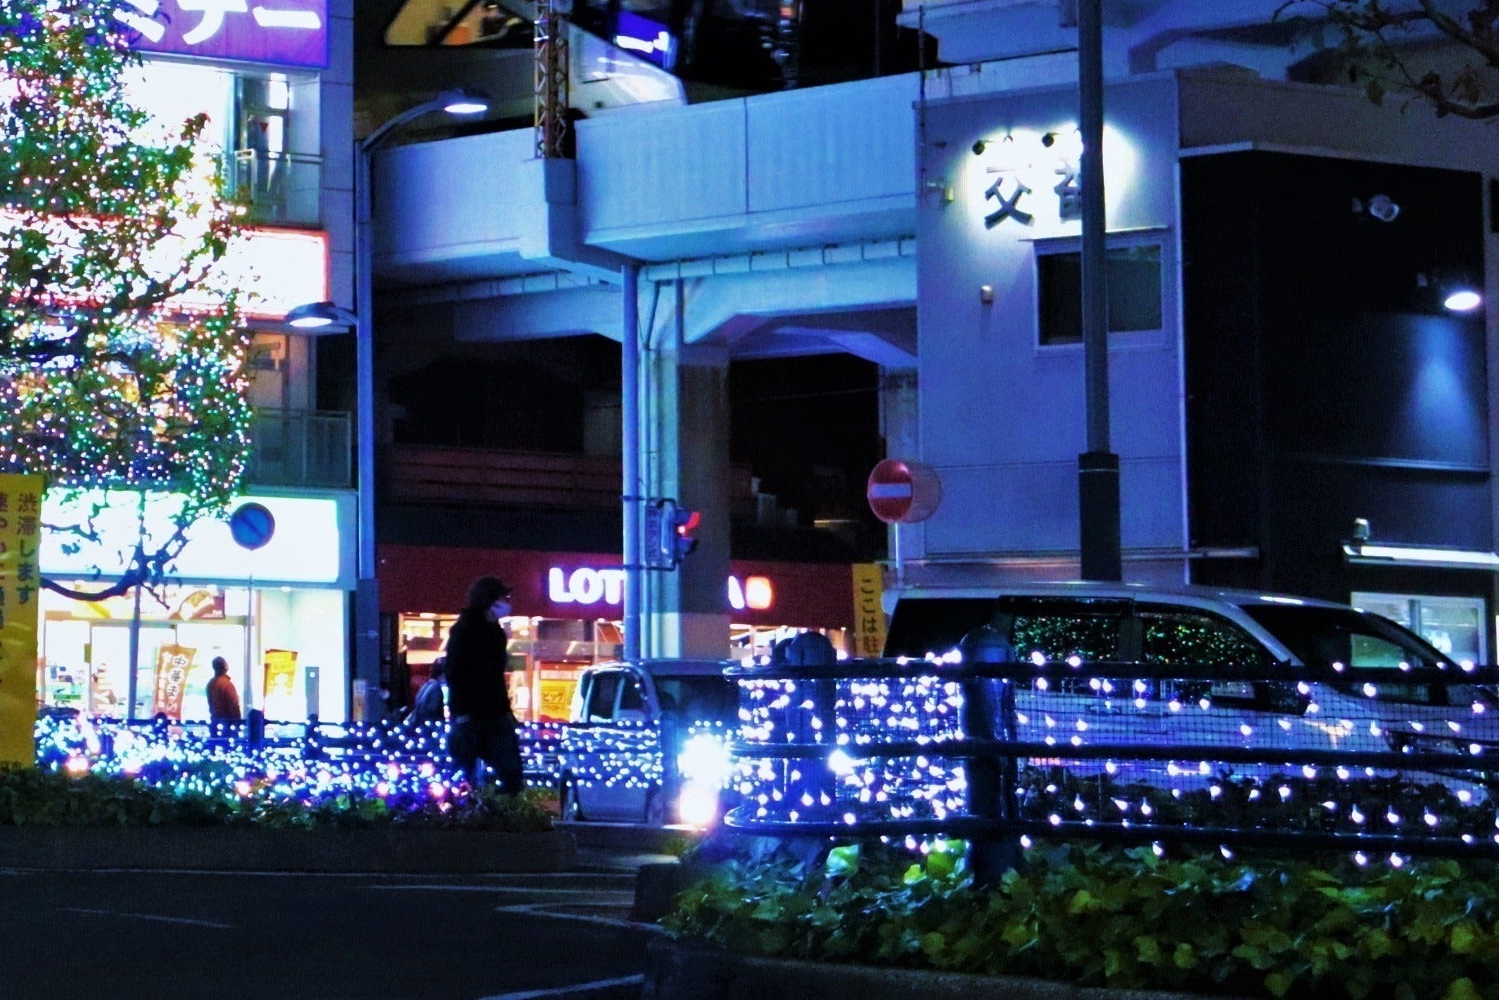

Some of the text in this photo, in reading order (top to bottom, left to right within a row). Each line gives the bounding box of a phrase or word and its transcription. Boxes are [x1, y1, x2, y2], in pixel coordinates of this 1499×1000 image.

[16, 492, 38, 605] 渋滞します
